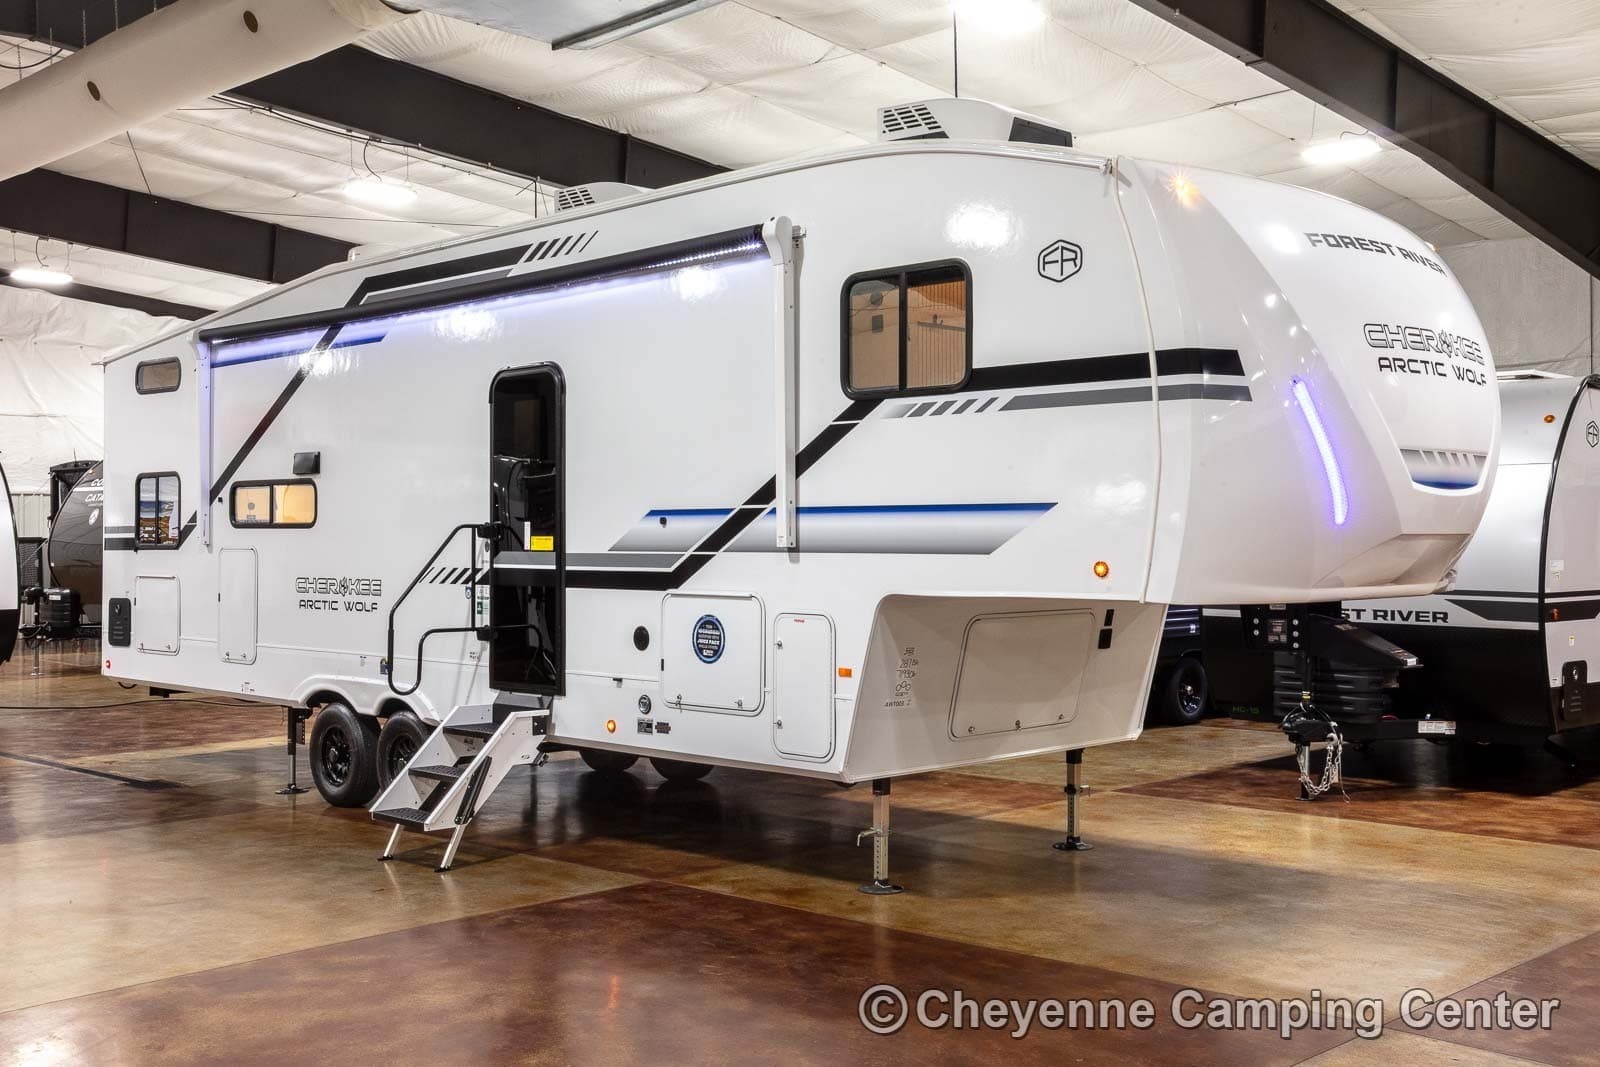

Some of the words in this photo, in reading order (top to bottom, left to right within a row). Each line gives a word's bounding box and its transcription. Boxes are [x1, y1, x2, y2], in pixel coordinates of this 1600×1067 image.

[1304, 232, 1396, 256] FOREST
[1397, 247, 1448, 277] RIVER
[1363, 323, 1485, 366] CHEROKEE
[1378, 357, 1447, 377] ARCTIC
[1452, 364, 1487, 386] WOLF
[296, 577, 382, 597] CHEROKEE
[299, 599, 339, 611] ARCTIC
[344, 601, 378, 612] WOLF
[1373, 608, 1449, 623] RIVER
